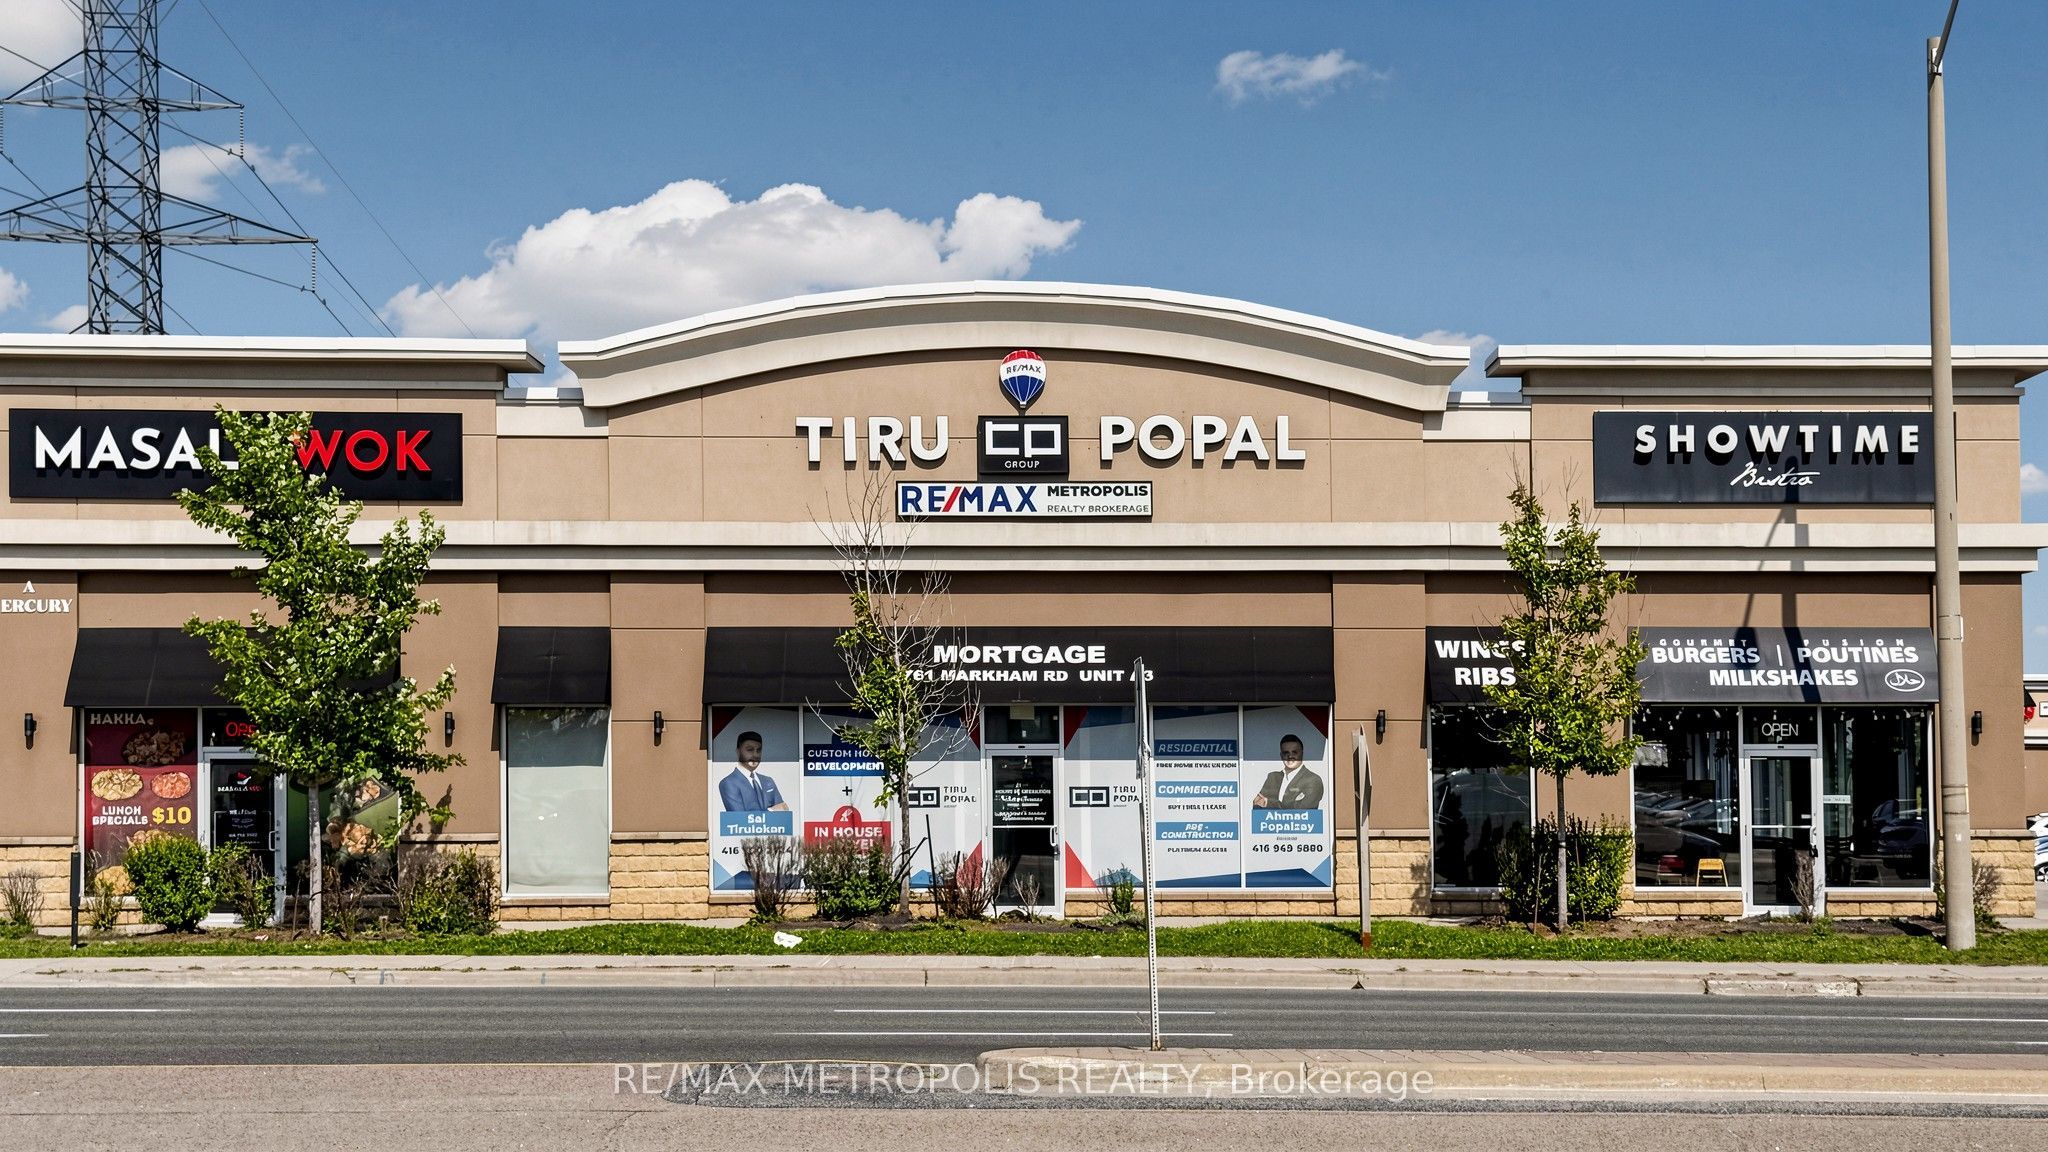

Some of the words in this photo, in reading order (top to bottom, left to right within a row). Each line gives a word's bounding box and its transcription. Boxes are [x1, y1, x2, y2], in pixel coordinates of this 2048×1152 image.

[1006, 364, 1041, 374] RE/MAX
[795, 415, 948, 462] TIRU
[1100, 415, 1306, 460] POPAL
[1635, 424, 1919, 454] SHOWTIME
[35, 425, 239, 470] MASAL
[296, 429, 432, 471] WOK
[1004, 461, 1040, 469] GROUP
[1730, 461, 1820, 487] Bistro
[901, 485, 1037, 512] RE/MAX
[1047, 485, 1148, 497] METROPOLIS
[1047, 505, 1085, 513] REALTY
[1088, 505, 1149, 513] BROKERAGE
[22, 580, 36, 593] A
[1659, 638, 1746, 647] GOURMET
[933, 645, 1106, 664] MORTGAGE
[1652, 647, 1760, 663] BURGERS
[1797, 646, 1919, 663] POUTINES
[940, 669, 1037, 682] MARKHAM
[1043, 670, 1069, 681] RD
[1079, 670, 1125, 681] UNIT
[1454, 667, 1517, 686] RIBS
[1709, 669, 1859, 686] MILKSHAKES
[90, 713, 146, 725] HAKKA
[1761, 722, 1799, 737] OPEN
[807, 749, 852, 758] CUSTOM
[1158, 743, 1234, 753] RESIDENTIAL
[943, 786, 967, 794] TIRU
[1158, 785, 1236, 794] COMMERCIAL
[102, 806, 142, 815] LUNCH
[151, 806, 192, 825] $10
[1265, 811, 1309, 820] Ahmad
[92, 816, 148, 826] SPECIALS
[747, 813, 766, 824] Sal
[727, 824, 785, 834] Tirulokan
[814, 827, 829, 838] IN
[833, 827, 883, 838] HOUSE
[1260, 822, 1314, 833] Popalzay
[1161, 831, 1234, 839] CONSTRUCTION
[721, 846, 740, 855] 416
